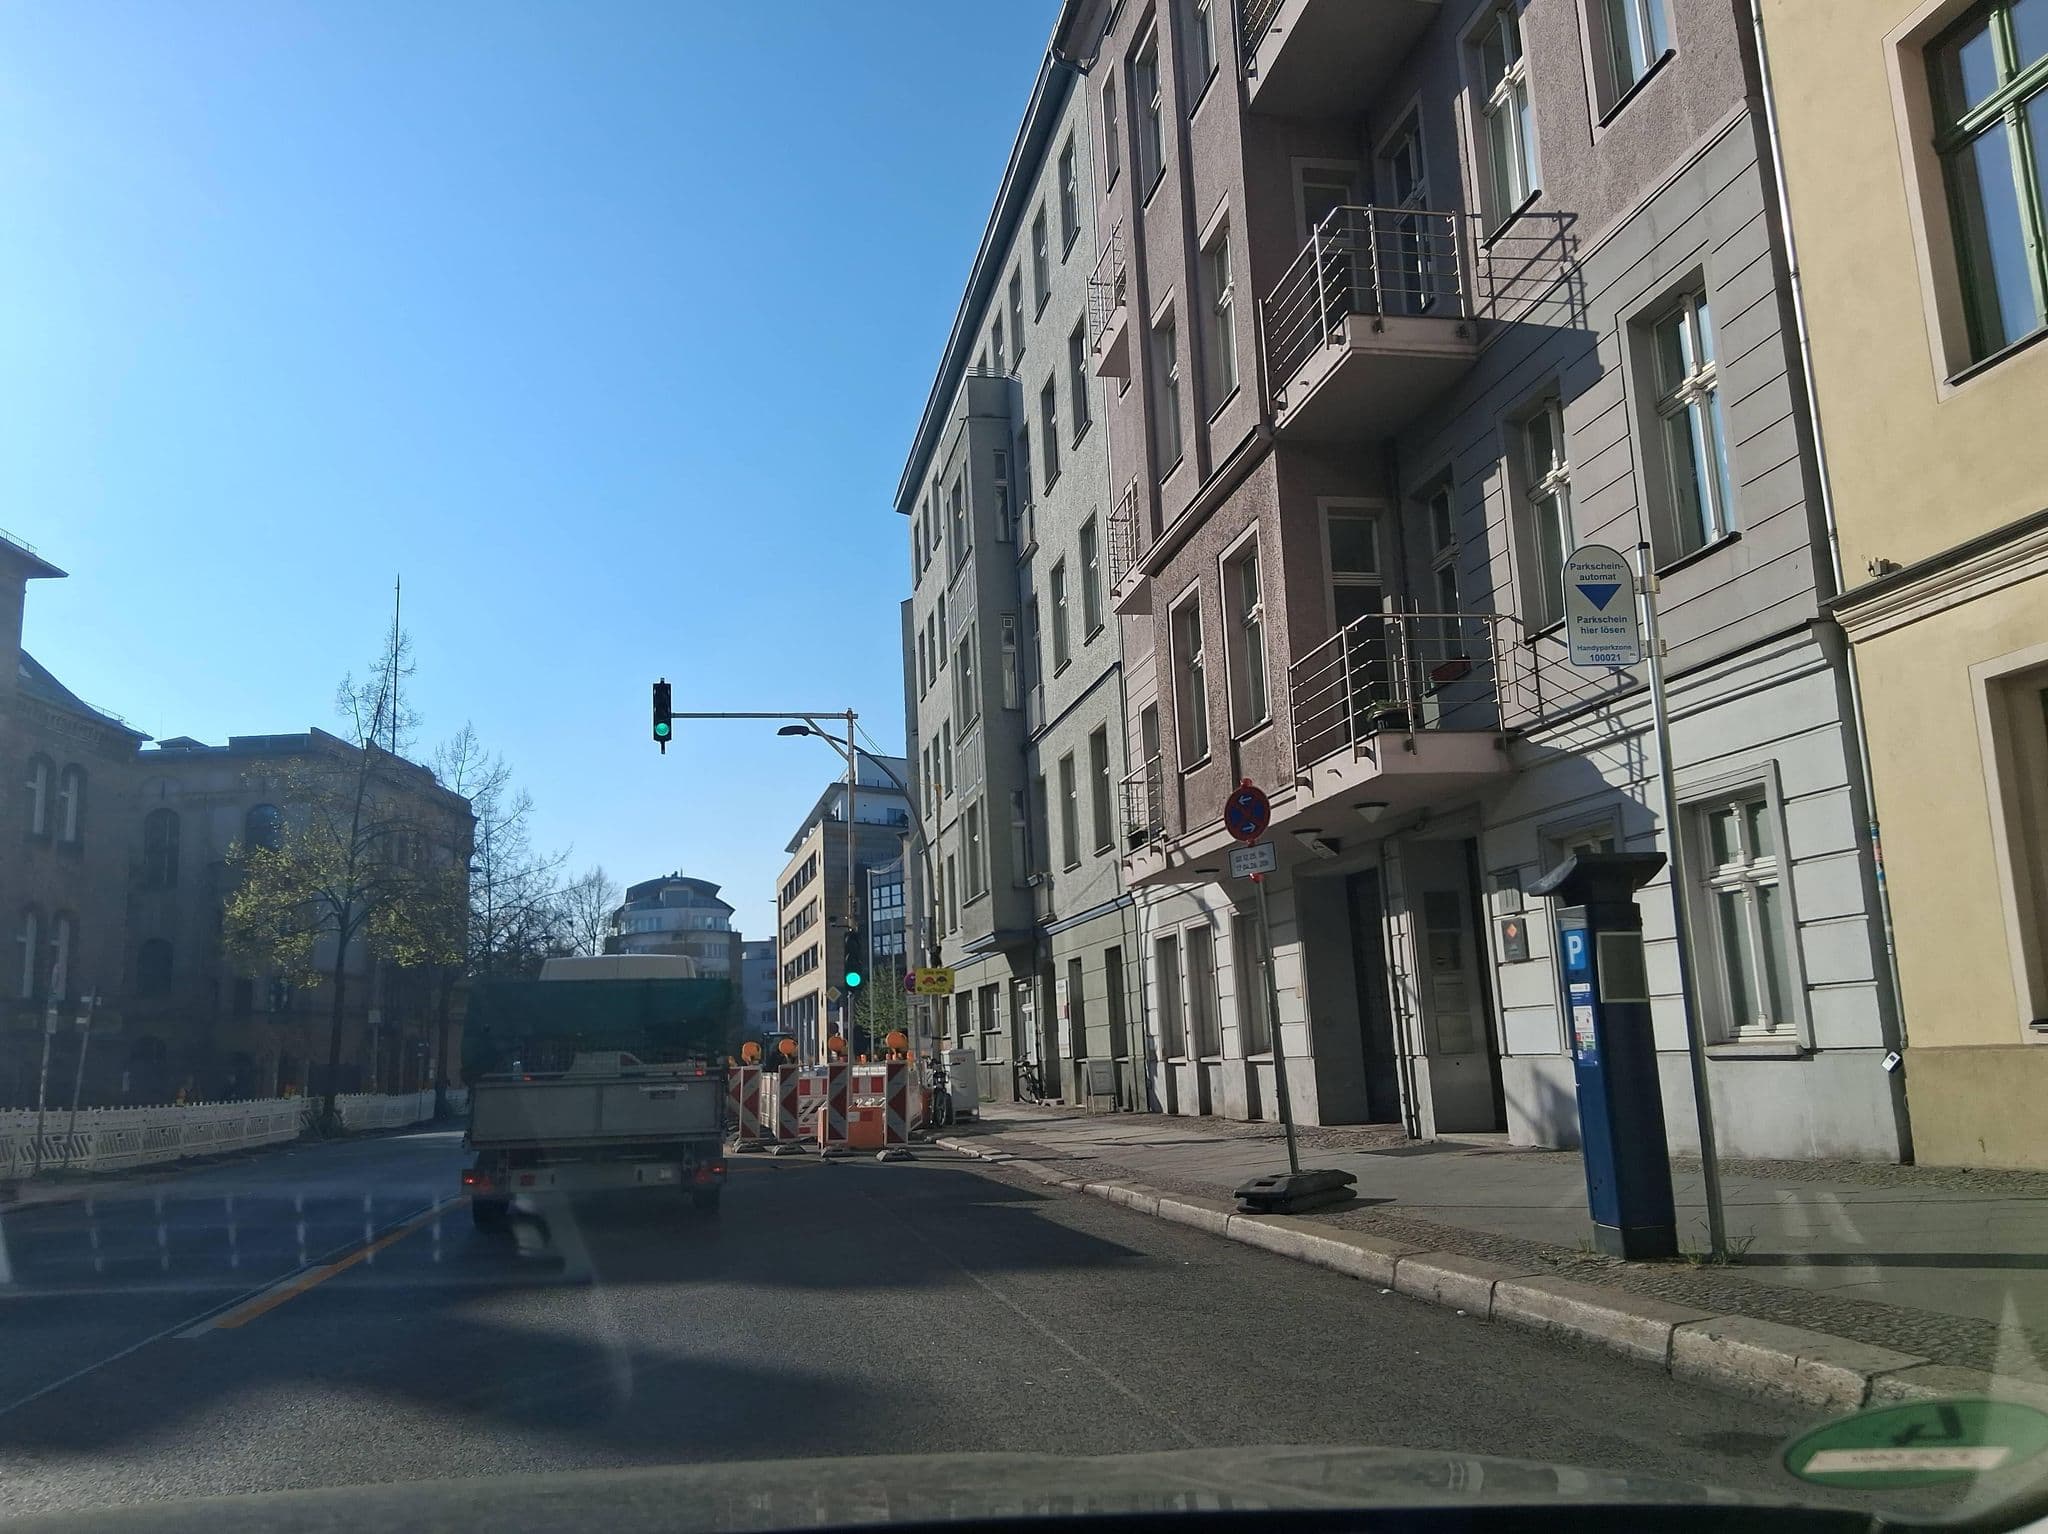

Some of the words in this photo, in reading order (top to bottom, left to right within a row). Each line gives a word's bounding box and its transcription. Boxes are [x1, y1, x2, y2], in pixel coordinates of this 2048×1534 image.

[1570, 562, 1624, 571] Parkschein-
[1580, 572, 1616, 580] automat
[1576, 615, 1627, 624] Parkschein
[1580, 626, 1598, 634] hier
[1600, 625, 1626, 634] lösen
[1577, 644, 1632, 653] Handyparkzone
[1590, 653, 1621, 662] 100021
[1567, 935, 1582, 965] P
